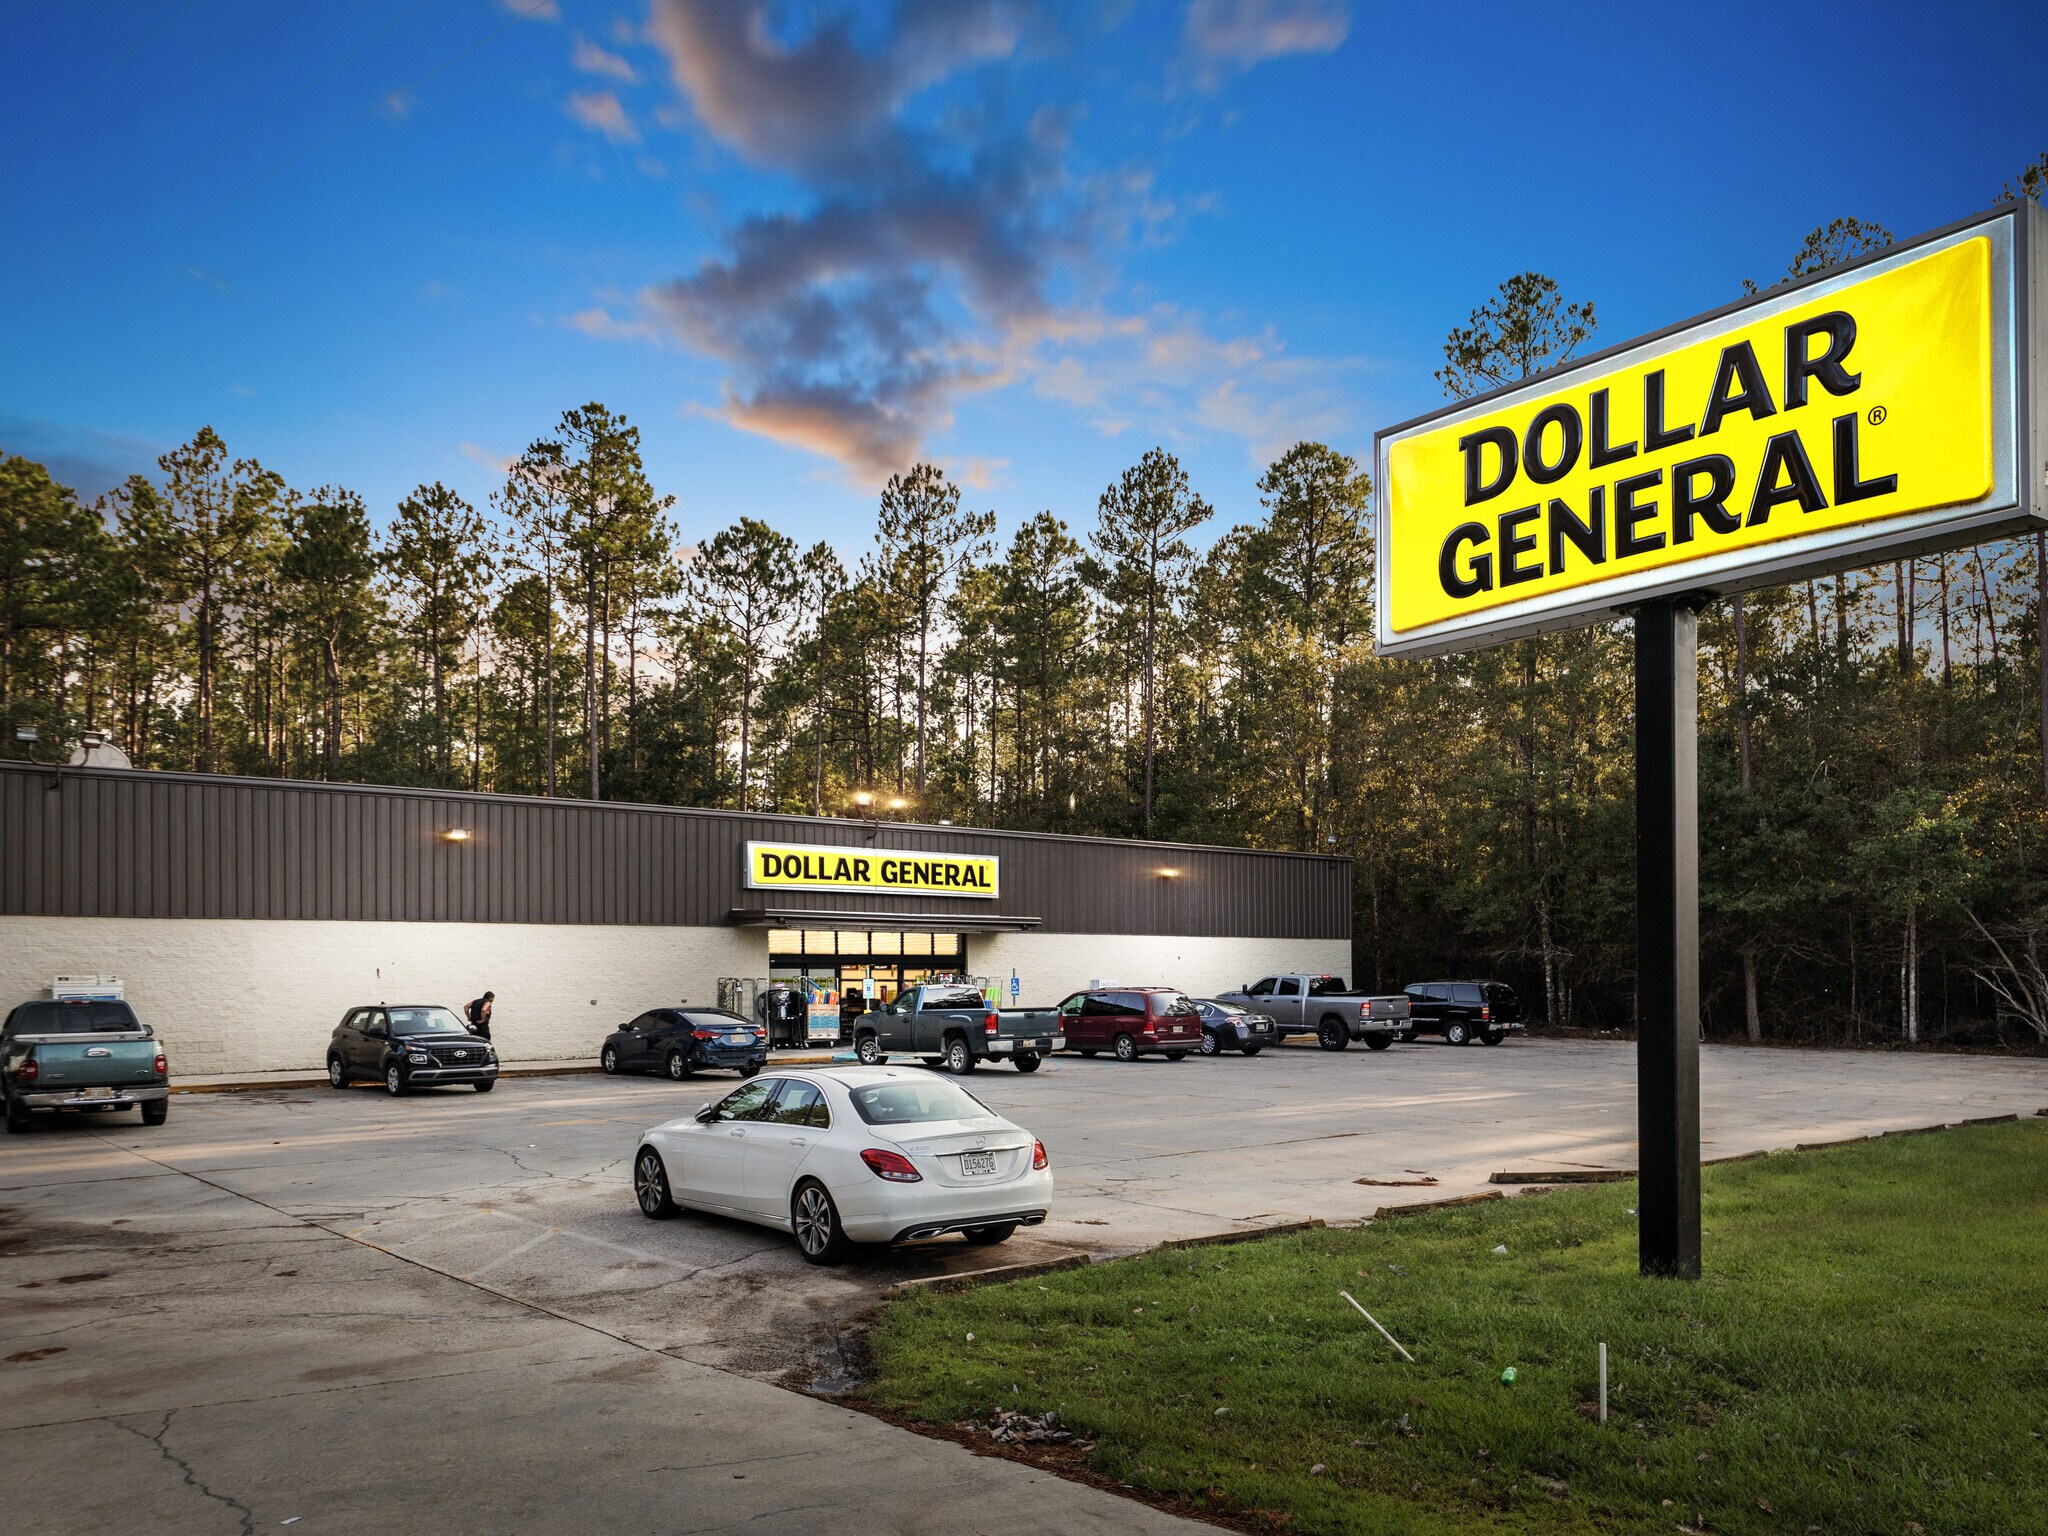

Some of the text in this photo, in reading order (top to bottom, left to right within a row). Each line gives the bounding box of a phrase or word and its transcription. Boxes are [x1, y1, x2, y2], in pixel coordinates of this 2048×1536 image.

[1459, 311, 1862, 506] DOLLAR
[1439, 412, 1898, 598] GENERAL
[761, 853, 991, 887] DOLLAR GENERAL
